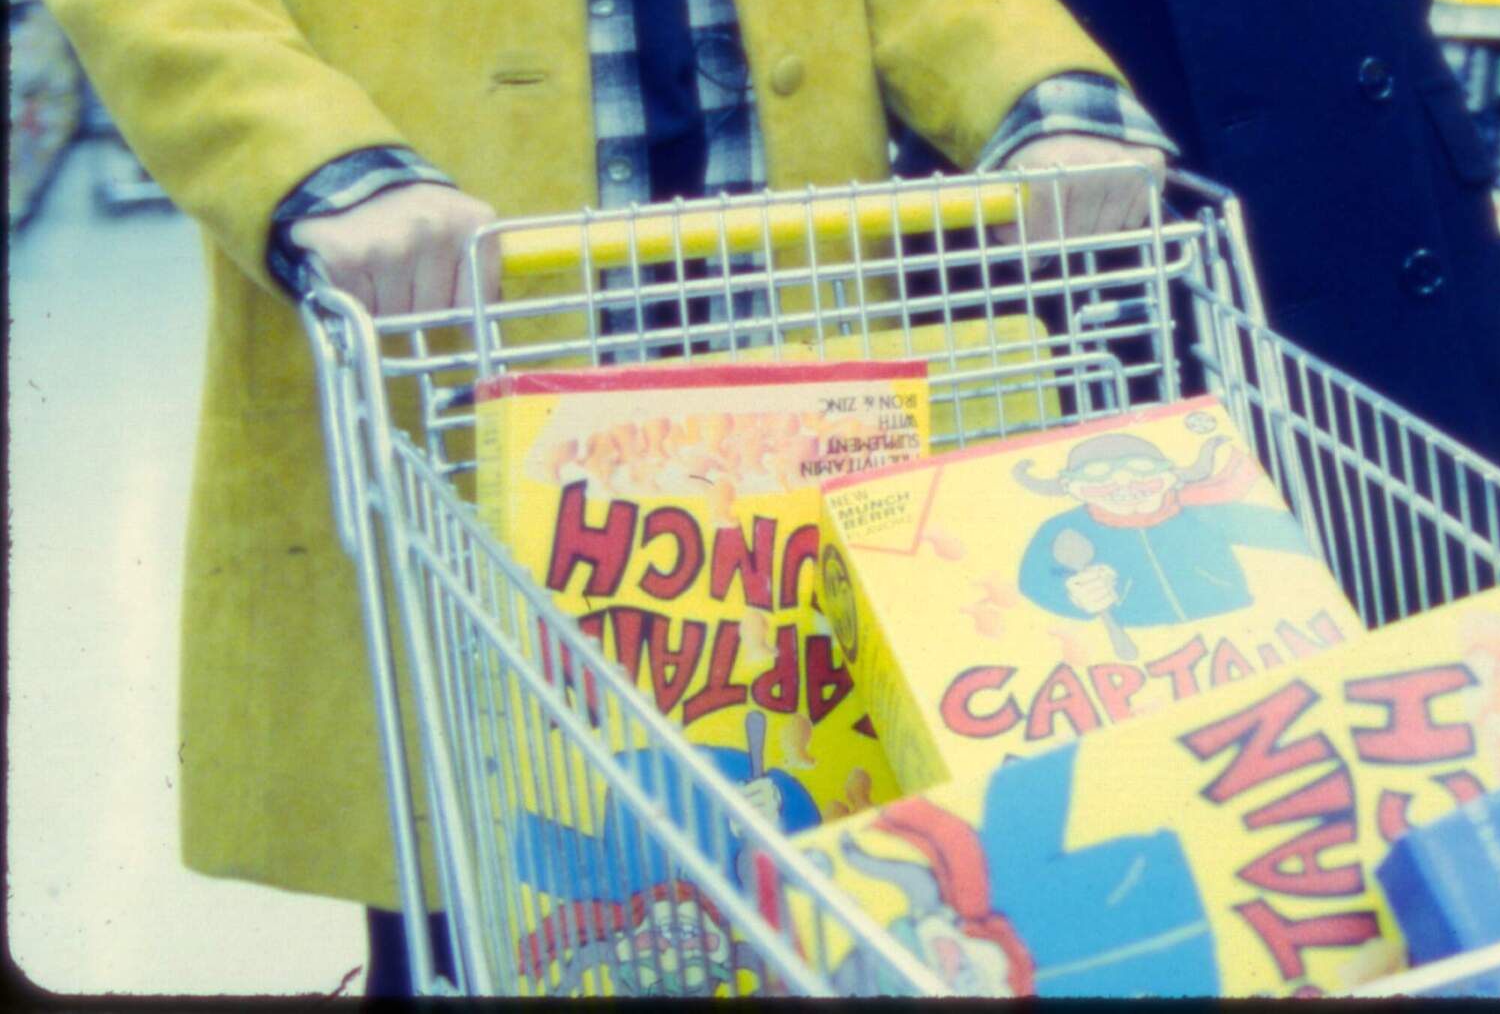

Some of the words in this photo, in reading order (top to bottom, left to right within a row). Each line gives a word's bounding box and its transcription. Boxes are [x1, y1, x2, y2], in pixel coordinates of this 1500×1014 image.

[819, 396, 857, 413] ZINC
[878, 394, 918, 410] IRON
[878, 413, 918, 431] WITH
[838, 491, 910, 521] MUNCH
[1177, 677, 1382, 997] TAIN
